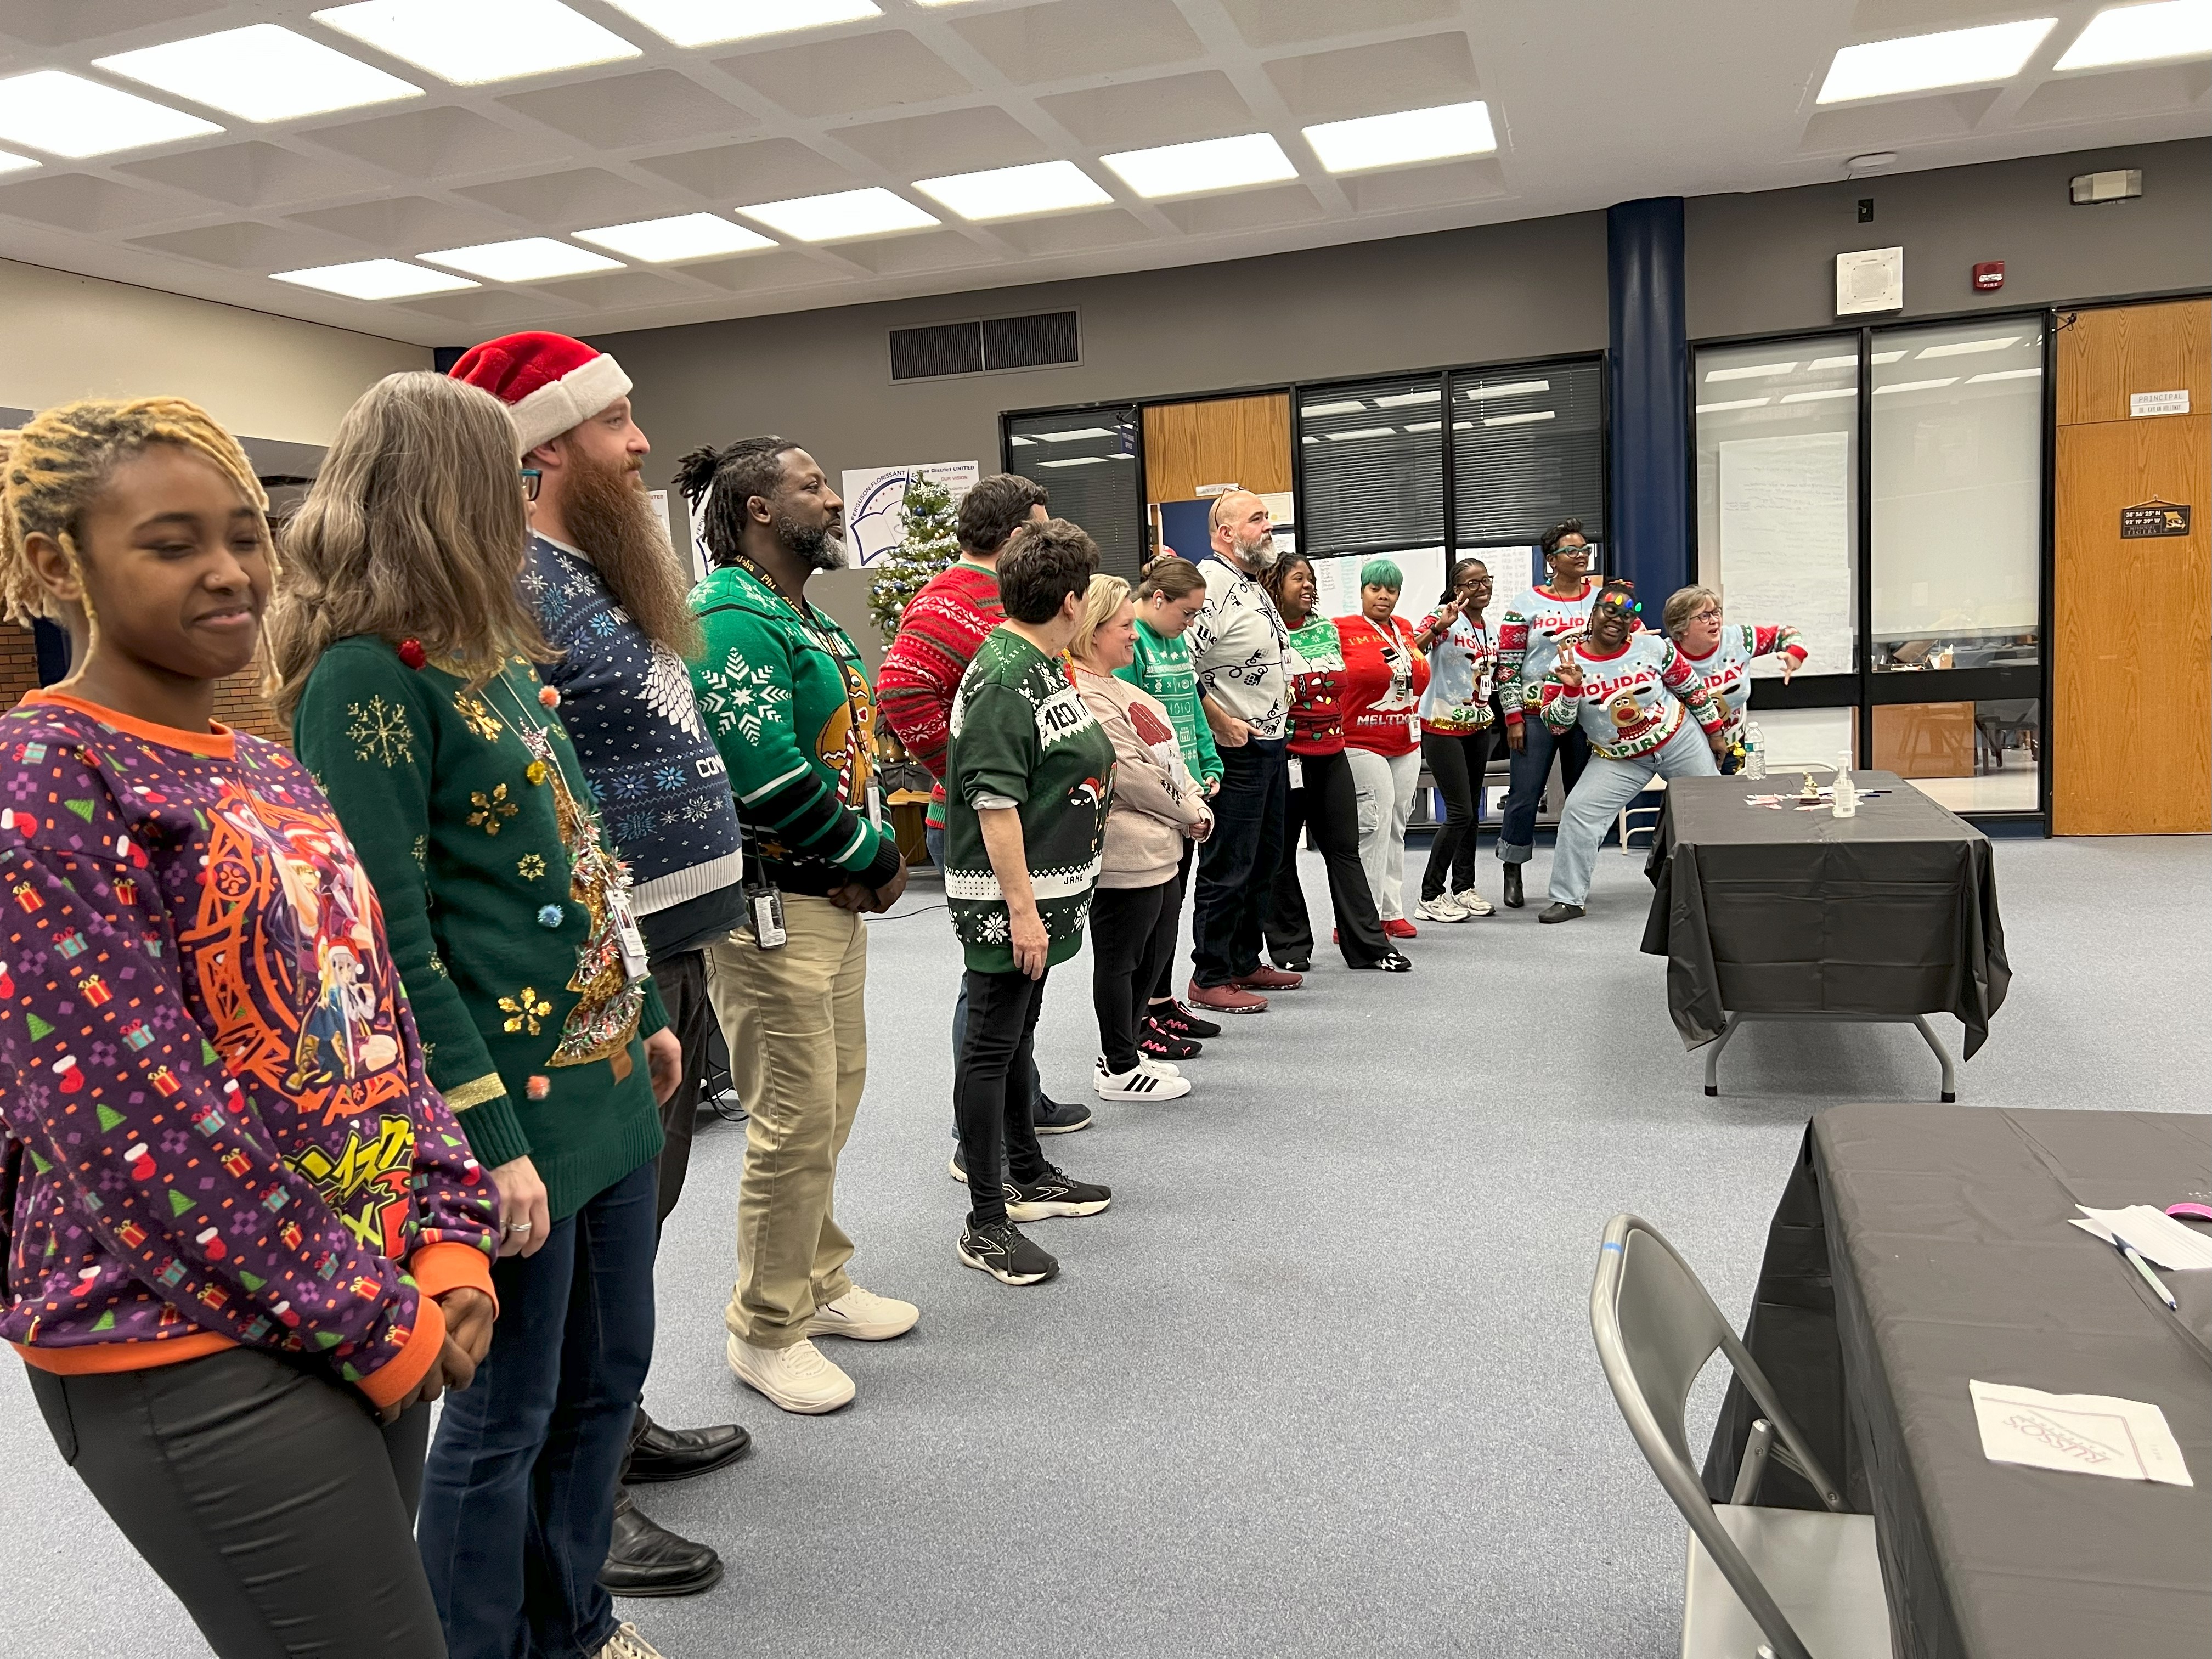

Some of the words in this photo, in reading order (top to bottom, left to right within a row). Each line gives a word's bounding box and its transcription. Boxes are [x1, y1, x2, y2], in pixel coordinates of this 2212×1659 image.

[2138, 393, 2182, 402] PRINCIPAL
[851, 470, 906, 521] FERGUSON-FLORISSANT
[760, 574, 777, 590] Phi
[1533, 617, 1585, 629] HOLID
[1348, 636, 1369, 645] I'M
[1064, 873, 1083, 884] JANE
